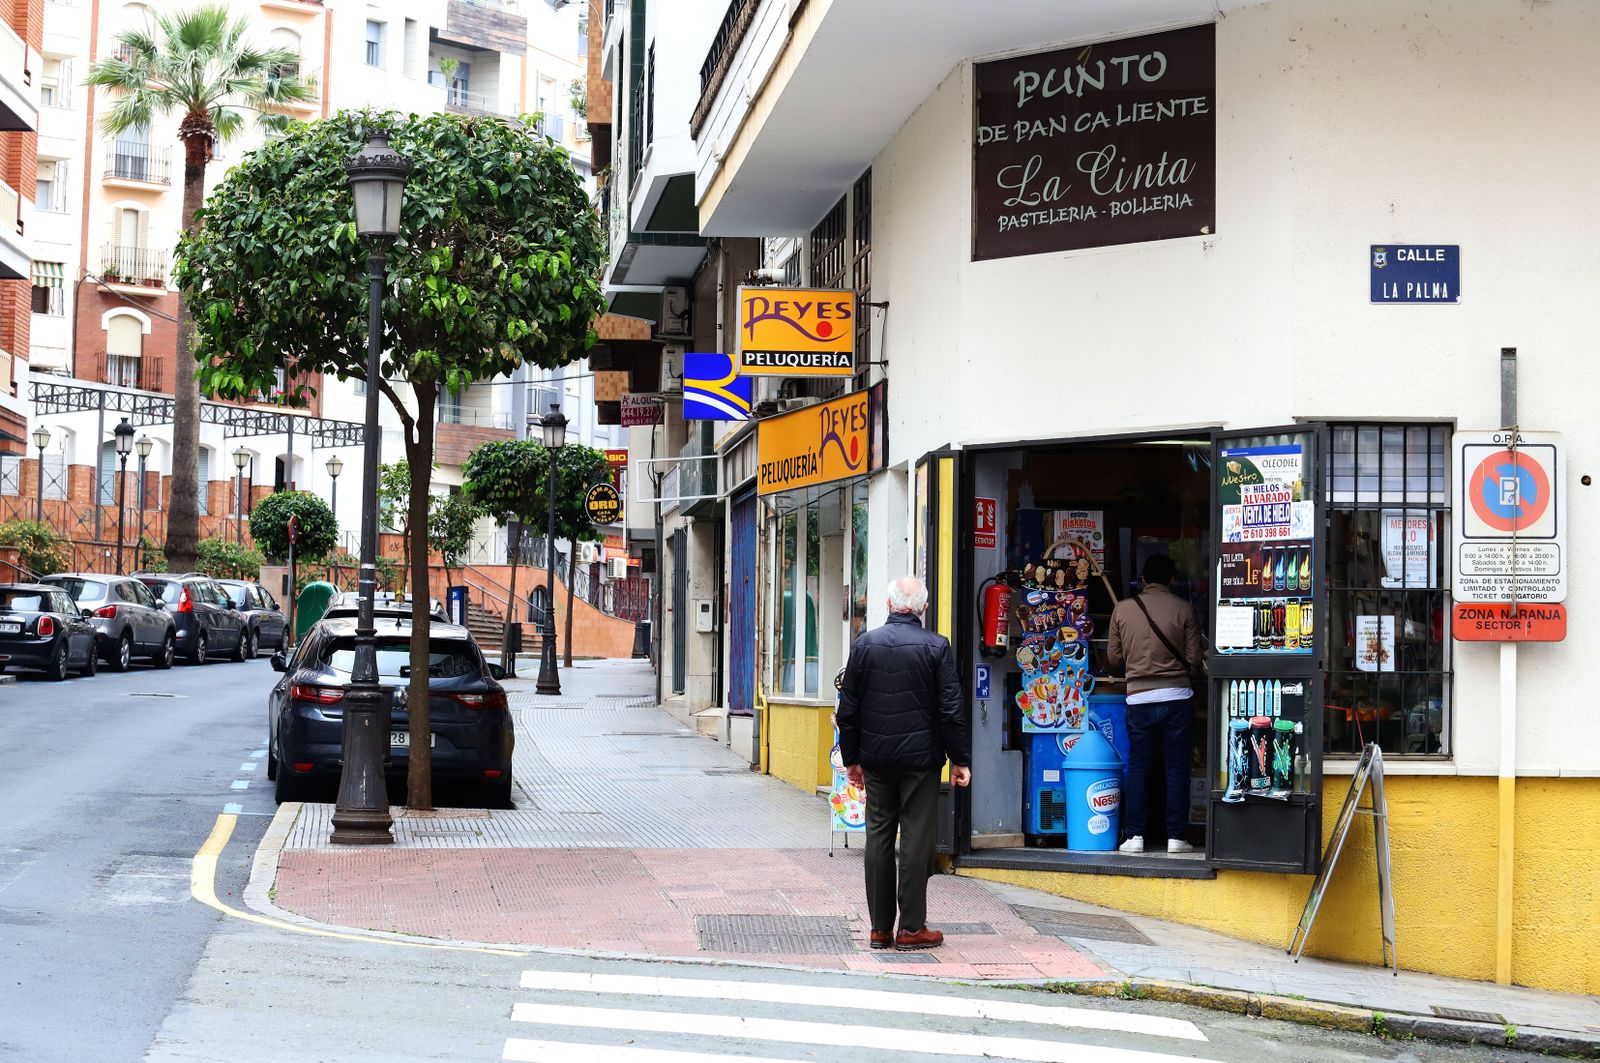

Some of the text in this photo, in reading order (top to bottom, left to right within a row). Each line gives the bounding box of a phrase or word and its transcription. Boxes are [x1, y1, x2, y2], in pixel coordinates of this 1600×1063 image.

[1013, 50, 1168, 108] PUNTO
[977, 124, 1009, 146] DE
[1014, 114, 1067, 143] PAN
[996, 144, 1196, 208] La Cinta
[997, 204, 1097, 233] PASTELERIA
[1109, 192, 1194, 218] BOLLERIA
[1397, 249, 1445, 261] CALLE
[1383, 282, 1448, 299] LA PALMA
[743, 296, 853, 343] REYES
[745, 351, 851, 368] PELUQUERÍA
[819, 399, 868, 478] REYES
[1493, 434, 1526, 443] O.RA.
[761, 448, 817, 485] PELUQUERÍA
[1262, 458, 1298, 468] OLEODIEL
[589, 487, 617, 500] COMPRO
[1253, 484, 1280, 493] HIELOS
[1243, 492, 1290, 504] ALVARADO
[589, 500, 618, 510] ORO
[1244, 504, 1263, 524] VENTA
[1263, 504, 1272, 524] DE
[1272, 502, 1290, 524] HIELO
[1391, 520, 1427, 529] MEORES
[1250, 529, 1263, 538] 610
[1264, 528, 1277, 538] 398
[1278, 527, 1290, 536] 661
[1223, 554, 1230, 562] TU
[1459, 608, 1560, 620] ZONA NARANJA
[1476, 621, 1520, 630] SECTOR
